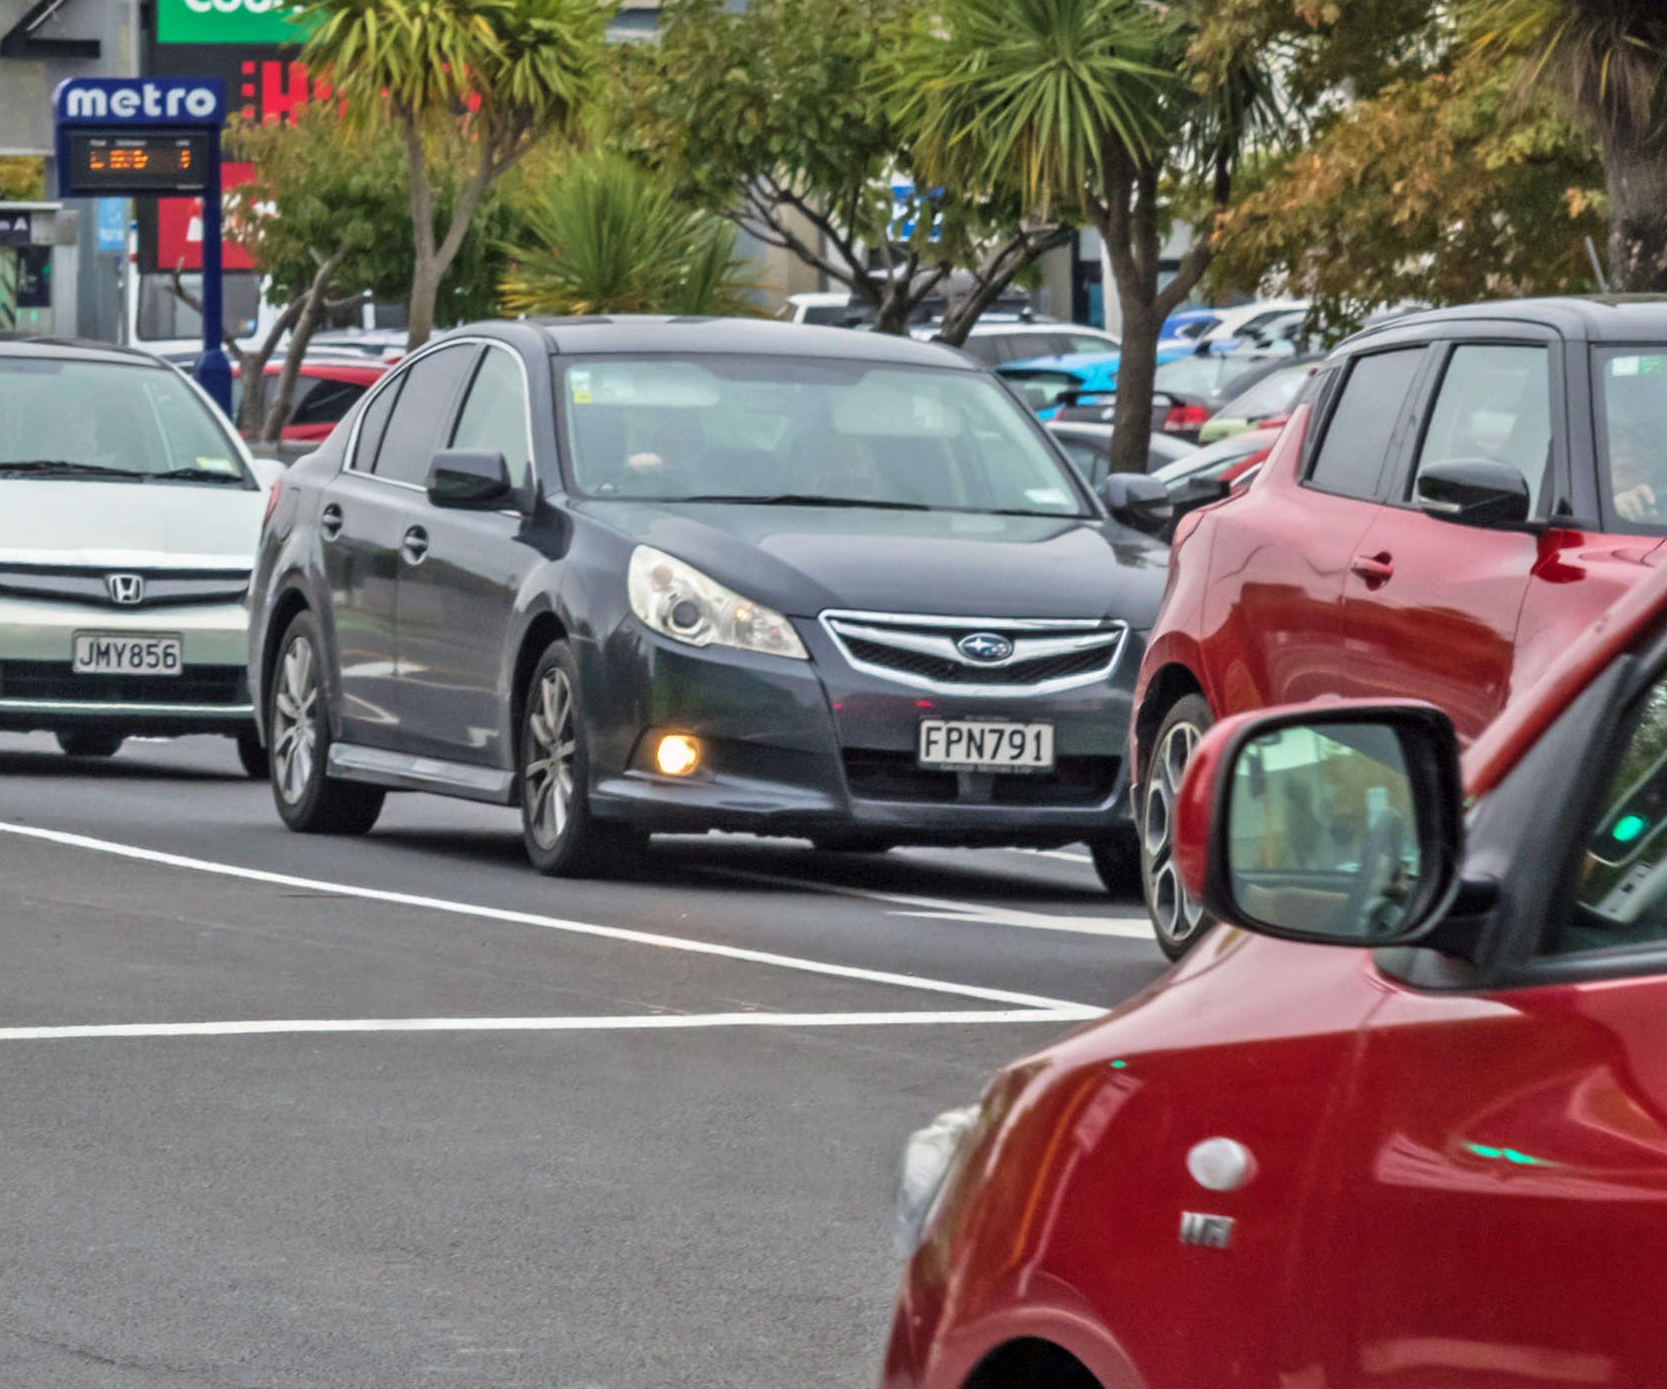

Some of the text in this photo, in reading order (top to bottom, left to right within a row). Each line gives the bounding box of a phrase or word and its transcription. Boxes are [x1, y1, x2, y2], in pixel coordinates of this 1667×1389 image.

[67, 83, 217, 118] metro
[79, 641, 177, 669] JMY856
[925, 726, 1042, 761] FPN791
